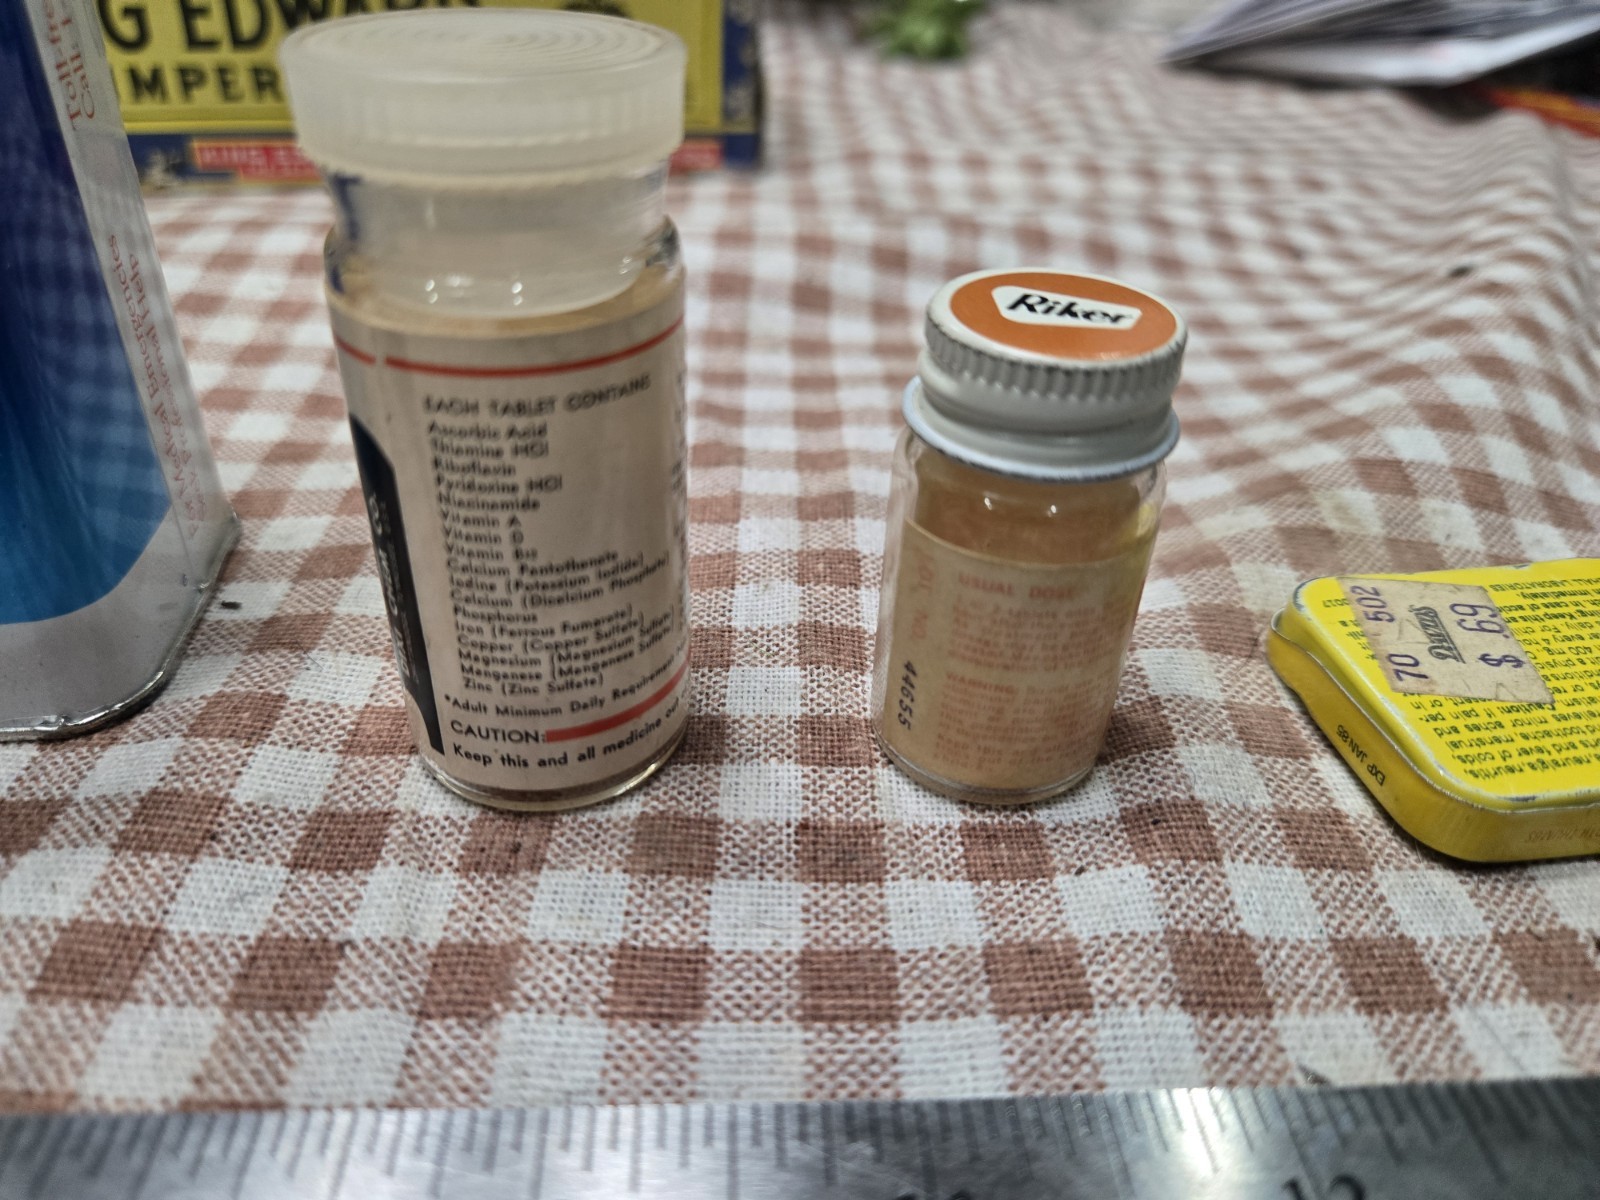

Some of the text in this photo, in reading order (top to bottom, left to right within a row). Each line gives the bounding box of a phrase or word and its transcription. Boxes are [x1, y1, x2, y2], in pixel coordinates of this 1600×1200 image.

[126, 63, 286, 105] MPER
[129, 253, 150, 321] Help
[108, 234, 160, 399] Emergencies
[1007, 293, 1132, 324] Riker
[505, 422, 548, 439] Acid
[154, 401, 187, 499] Medical
[441, 508, 500, 528] Vitamin
[443, 525, 502, 544] Vitamin
[445, 542, 503, 561] Vitamin
[447, 558, 510, 577] Calcium
[449, 575, 497, 593] Iodine
[451, 588, 513, 608] Calcium
[1351, 585, 1396, 624] 502
[1527, 603, 1541, 612] of
[1540, 601, 1569, 609] case
[454, 604, 538, 624] Phosphorus
[1519, 614, 1545, 624] this
[1543, 612, 1578, 621] Keep
[455, 620, 484, 635] Iron
[1539, 624, 1561, 633] For
[457, 633, 514, 653] Copper
[523, 635, 589, 654] (Copper
[1552, 634, 1586, 643] every
[458, 648, 542, 667] Magnesium
[1567, 646, 1592, 656] 400
[461, 662, 543, 682] Manganese
[1386, 653, 1429, 682] 70
[463, 677, 493, 694] Zinc
[502, 678, 539, 697] (Zinc
[897, 660, 918, 731] 44655
[1570, 684, 1585, 692] or
[496, 701, 562, 717] Minimum
[571, 695, 605, 714] Daily
[1410, 701, 1428, 712] in
[1429, 699, 1443, 708] or
[1418, 711, 1447, 723] per-
[1449, 707, 1479, 721] pain
[1510, 716, 1549, 729] minor
[450, 719, 546, 745] CAUTION:
[1434, 726, 1461, 739] and
[1464, 721, 1505, 733] aches
[454, 742, 492, 767] Keep
[500, 751, 529, 769] this
[538, 751, 568, 768] and
[577, 743, 596, 762] all
[602, 718, 661, 757] medicine
[1445, 734, 1515, 753] menstrual
[1516, 746, 1552, 757] fever
[1551, 742, 1579, 755] and
[1336, 724, 1386, 787] EXP JAN 85
[1451, 752, 1496, 765] colds,
[1497, 750, 1513, 762] of
